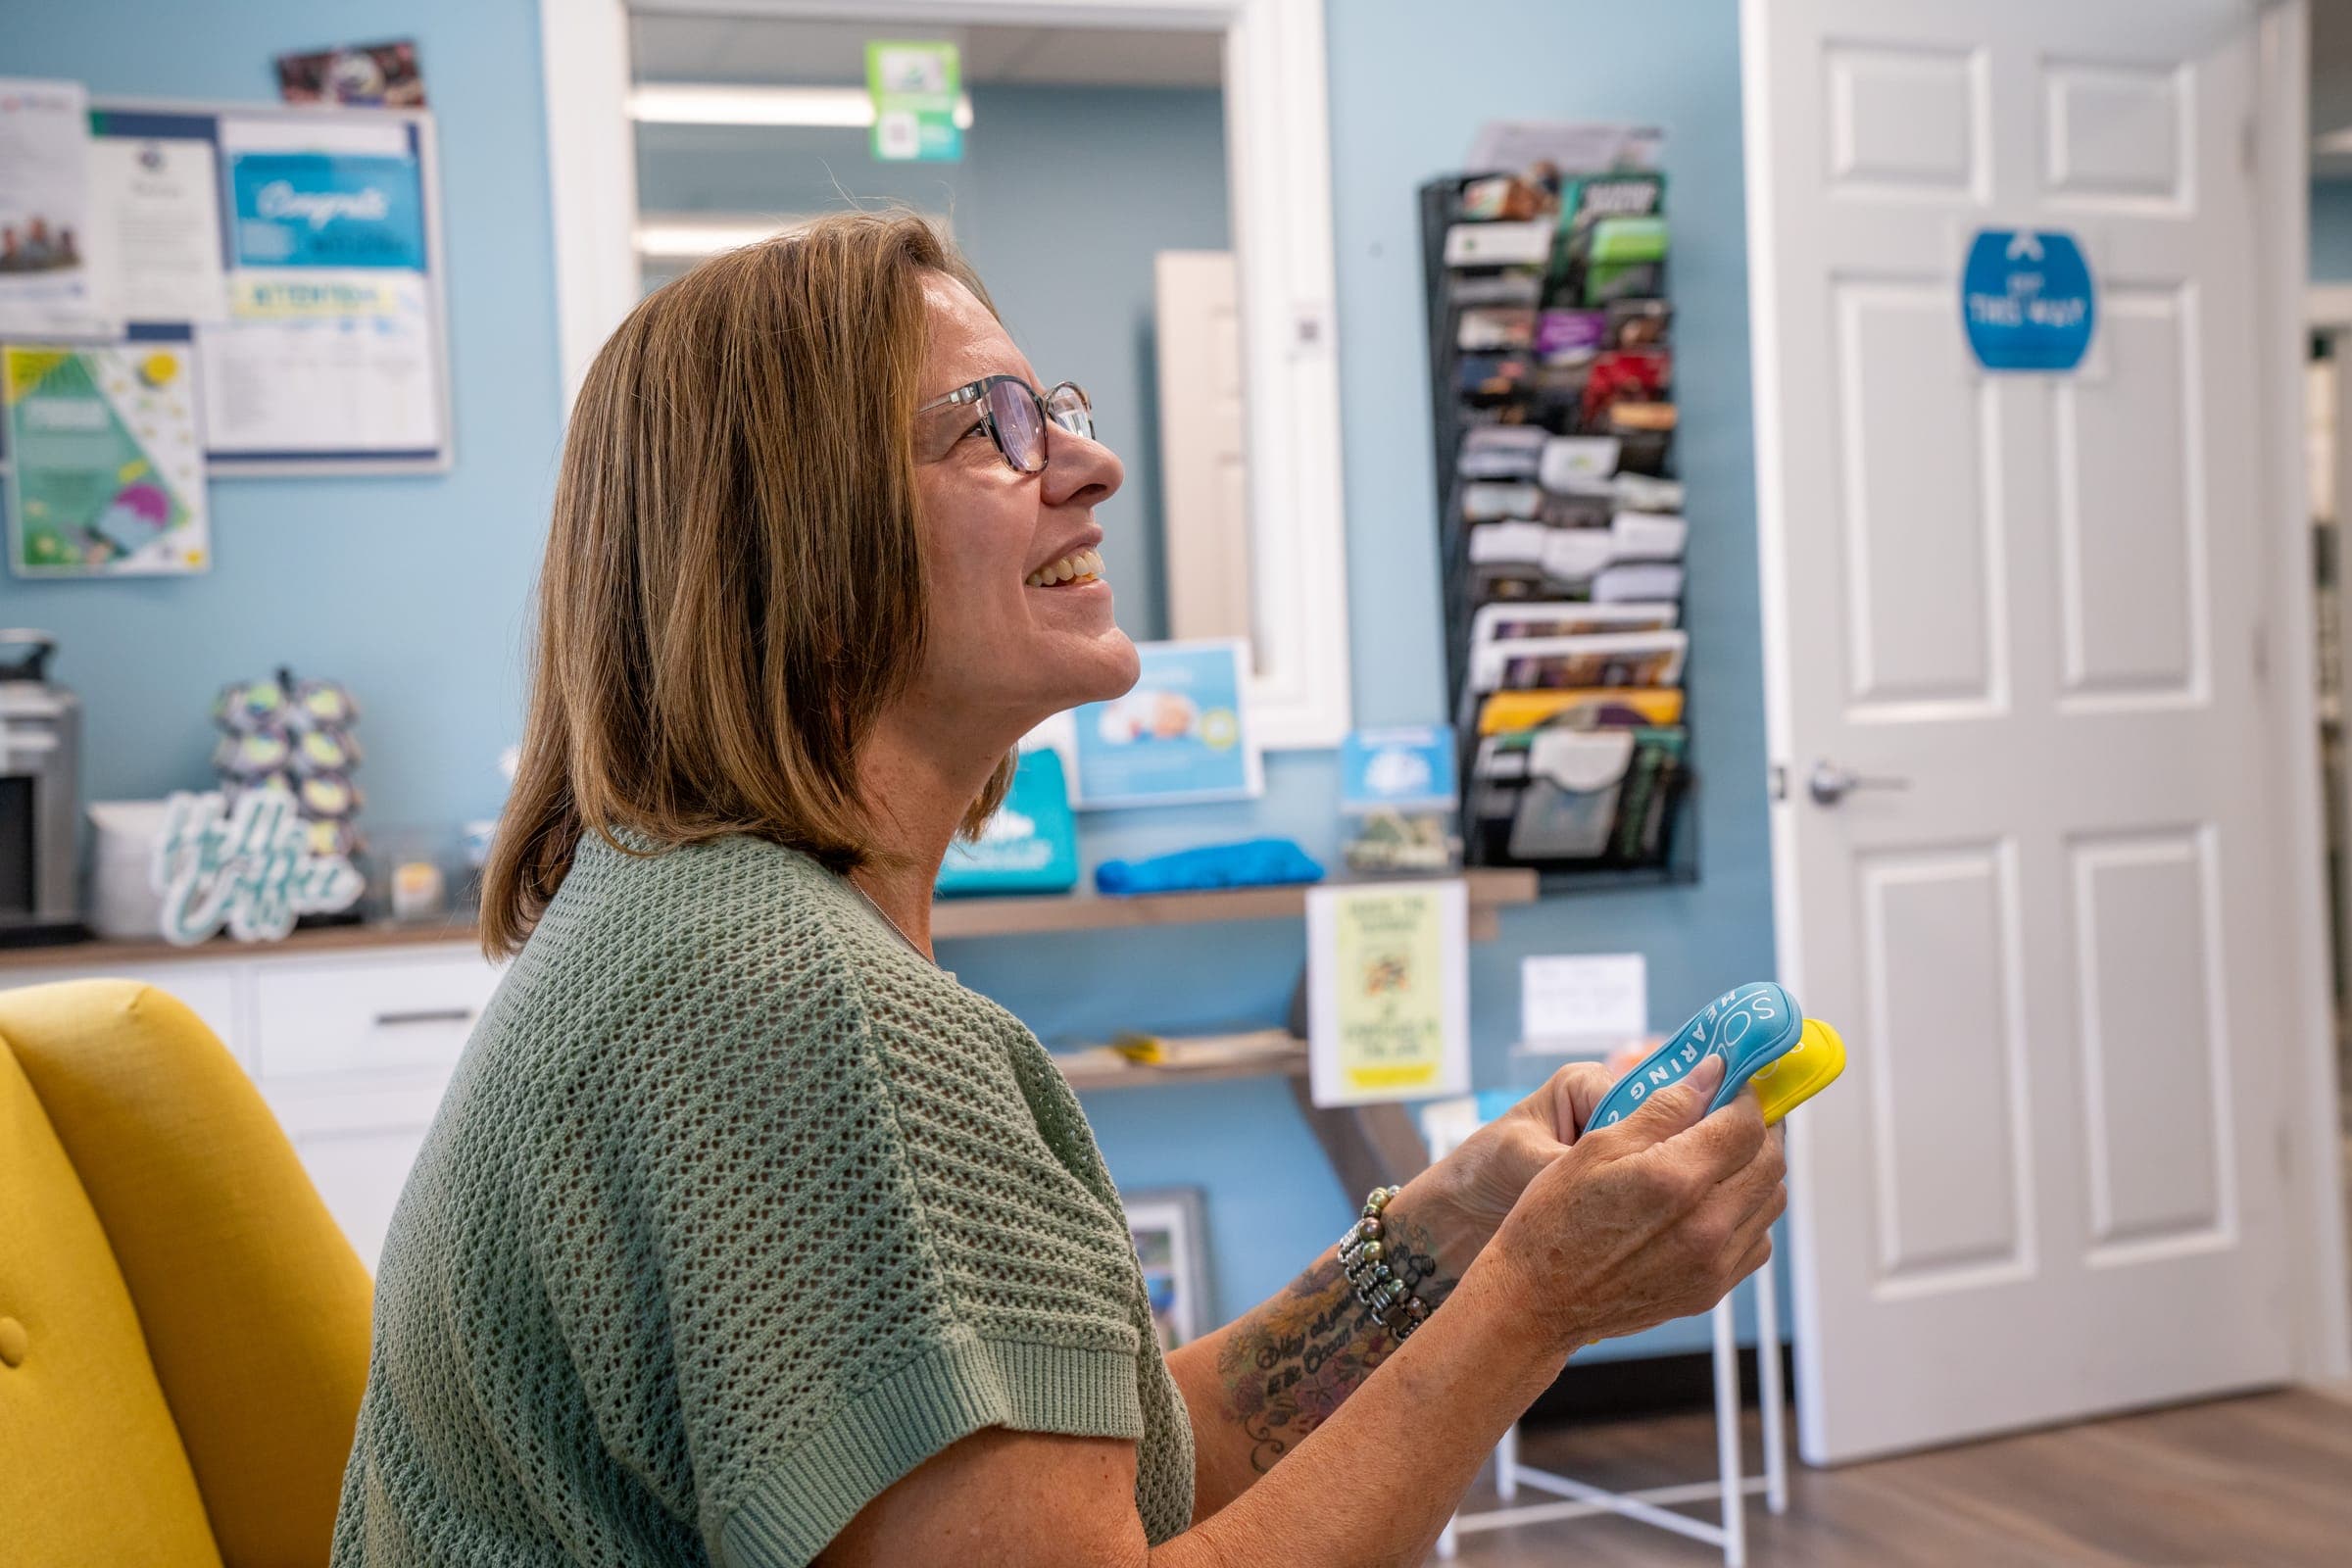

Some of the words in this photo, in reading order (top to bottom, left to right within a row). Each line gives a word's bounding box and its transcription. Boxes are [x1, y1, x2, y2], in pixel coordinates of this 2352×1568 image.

[155, 793, 311, 878] Hello
[167, 847, 359, 939] Coffee
[1629, 990, 1736, 1101] HEARING
